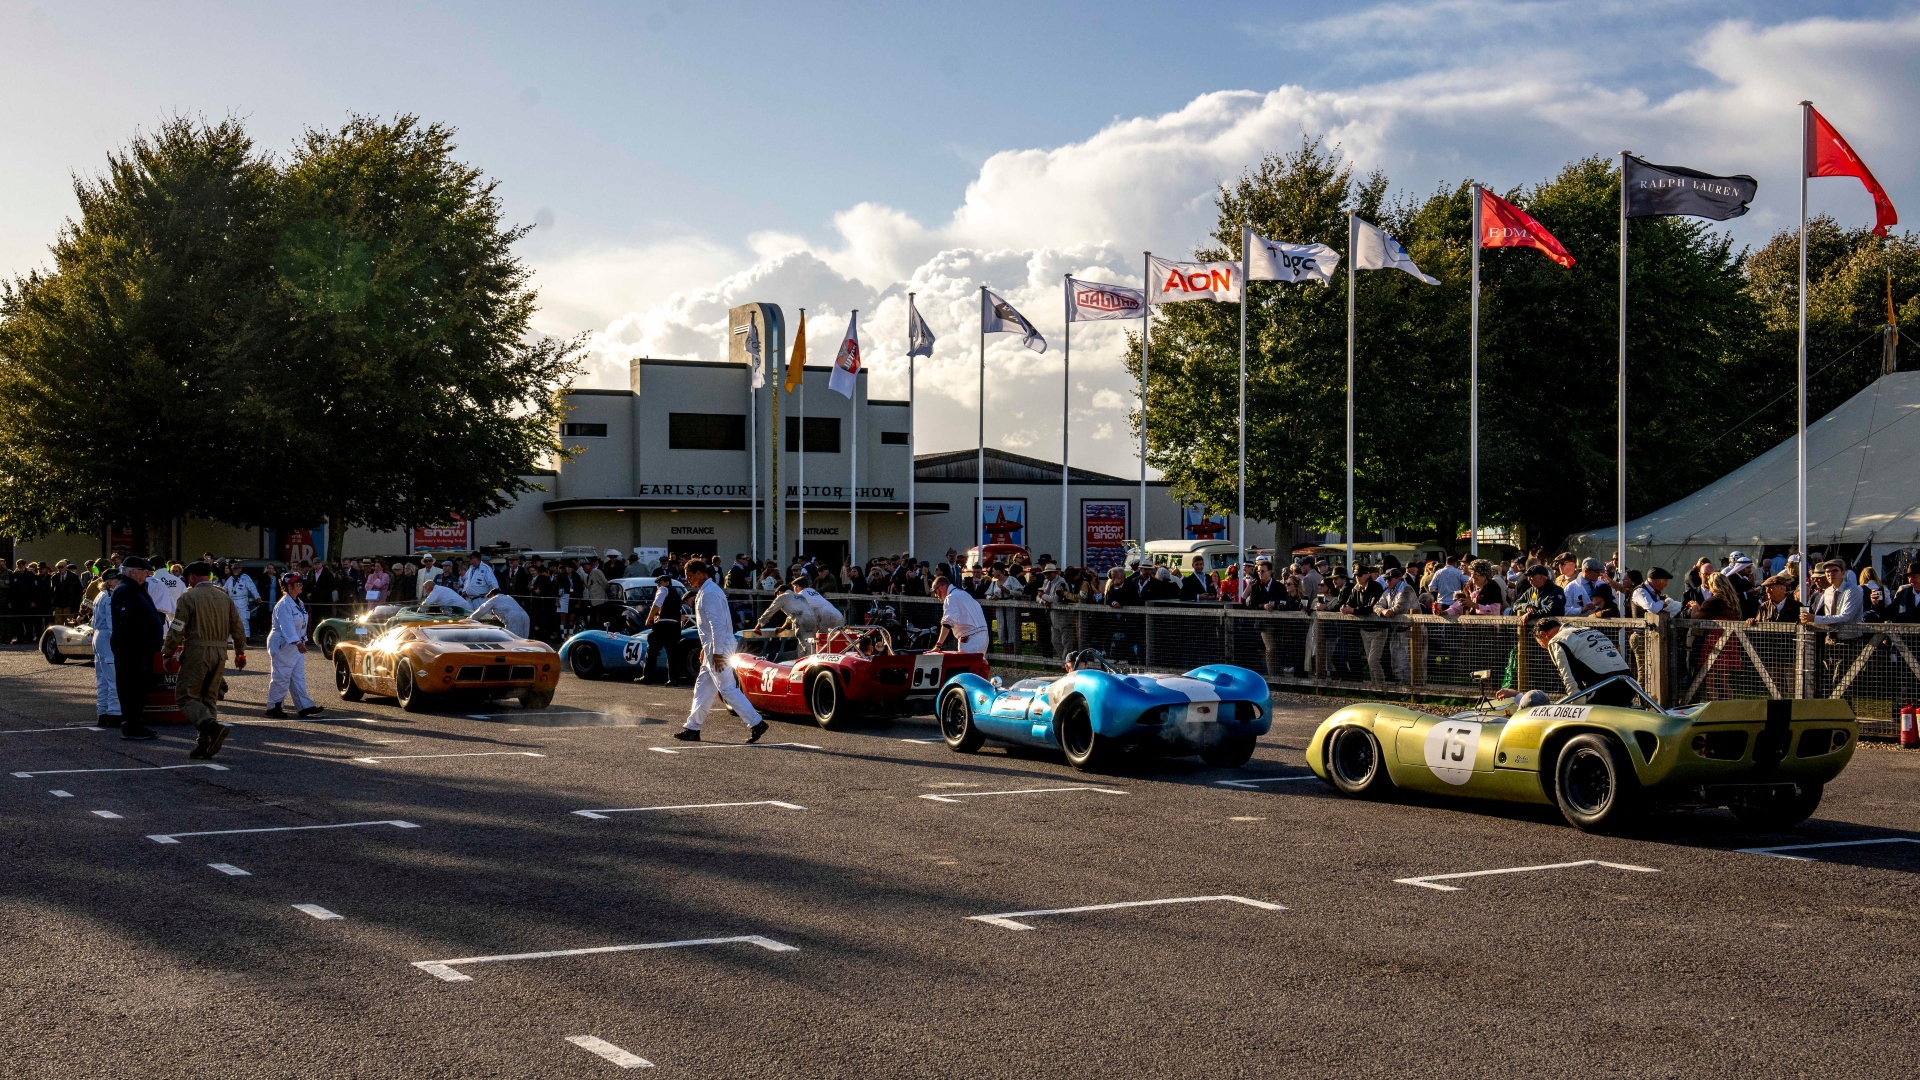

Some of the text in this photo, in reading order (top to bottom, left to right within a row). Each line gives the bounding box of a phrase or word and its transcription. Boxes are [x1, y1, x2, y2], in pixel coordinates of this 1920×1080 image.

[1640, 178, 1740, 197] RALPH LAUREN
[1163, 268, 1231, 293] AON
[640, 484, 695, 495] EARLS
[701, 485, 758, 496] COUR
[786, 486, 843, 497] MOTOR
[424, 528, 465, 537] show
[671, 526, 715, 535] ENTRANCE
[1087, 525, 1124, 533] motor
[1093, 531, 1124, 540] show
[625, 642, 641, 662] 54
[760, 666, 779, 693] 58
[1530, 706, 1586, 719] H.P.K. DIBLEY
[1441, 727, 1472, 762] 15
